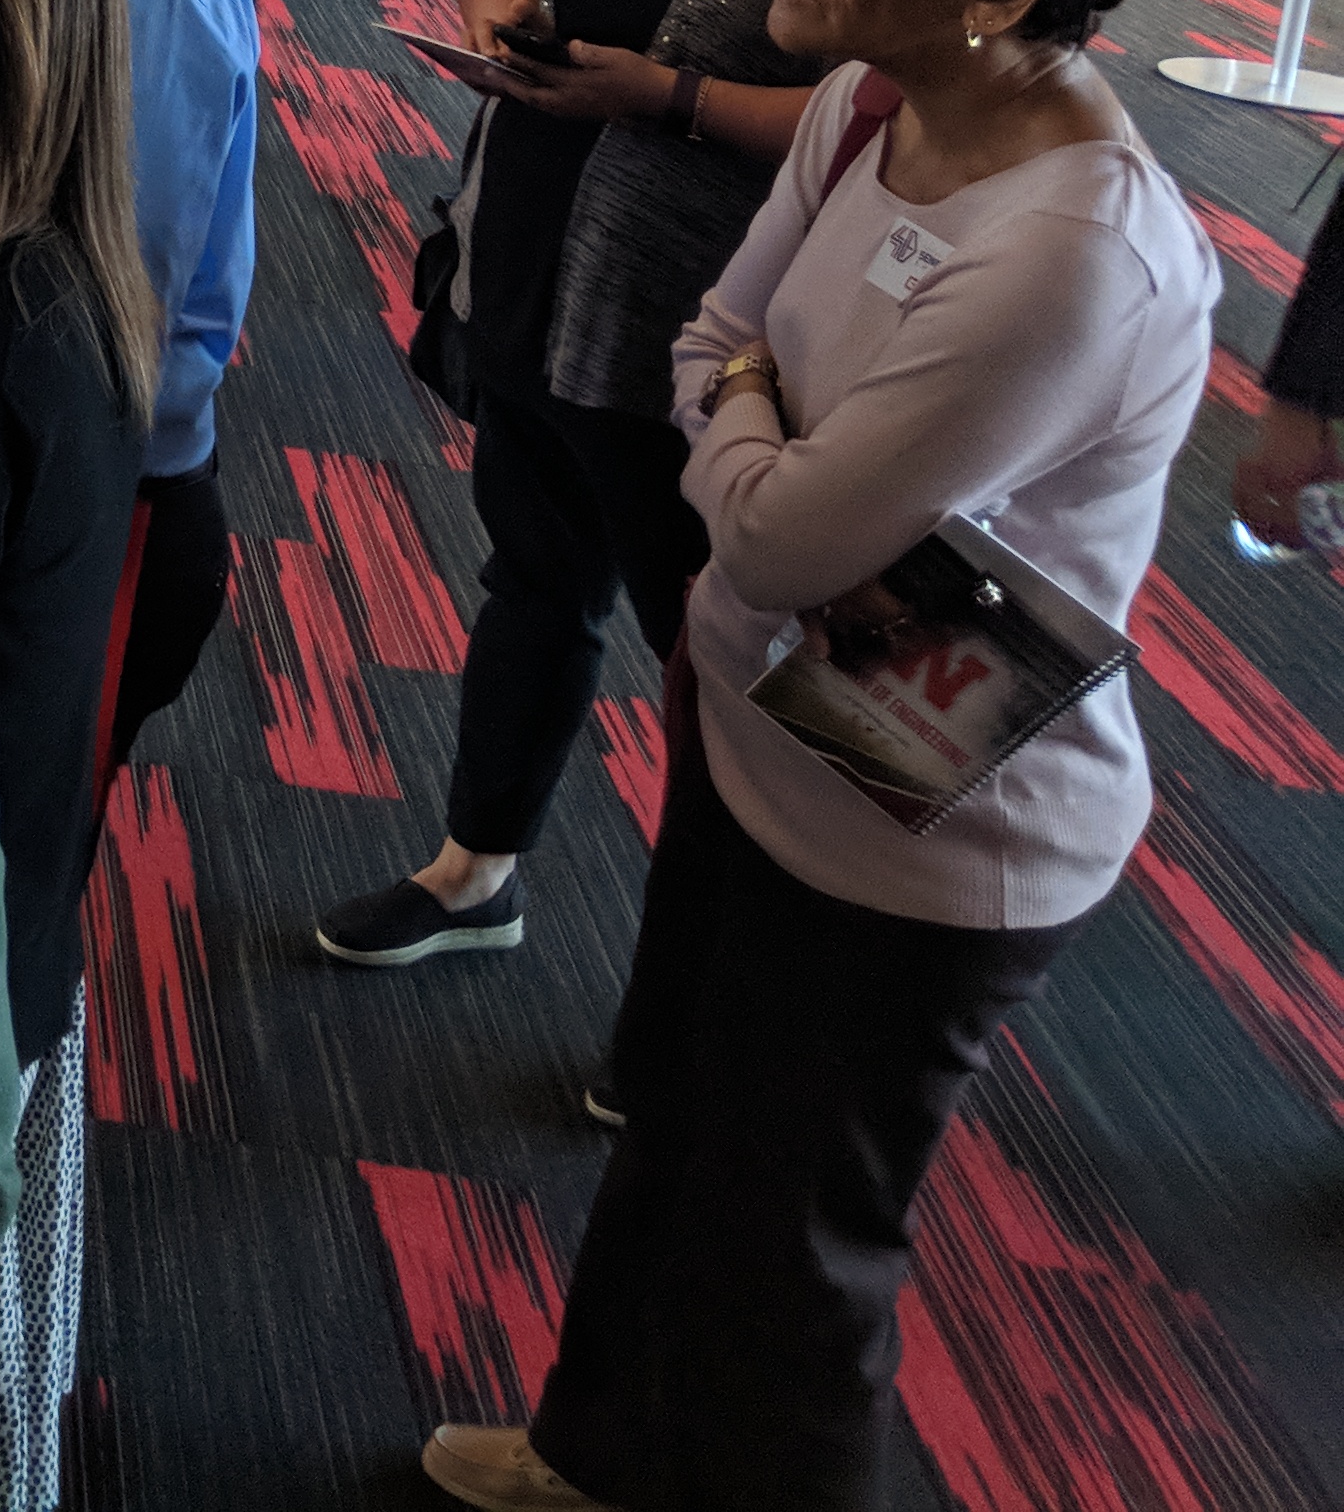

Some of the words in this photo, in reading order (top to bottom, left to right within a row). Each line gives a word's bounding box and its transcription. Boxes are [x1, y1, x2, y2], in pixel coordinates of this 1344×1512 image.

[886, 643, 992, 712] N
[870, 682, 893, 704] OF
[888, 697, 971, 768] ENGINEERING
